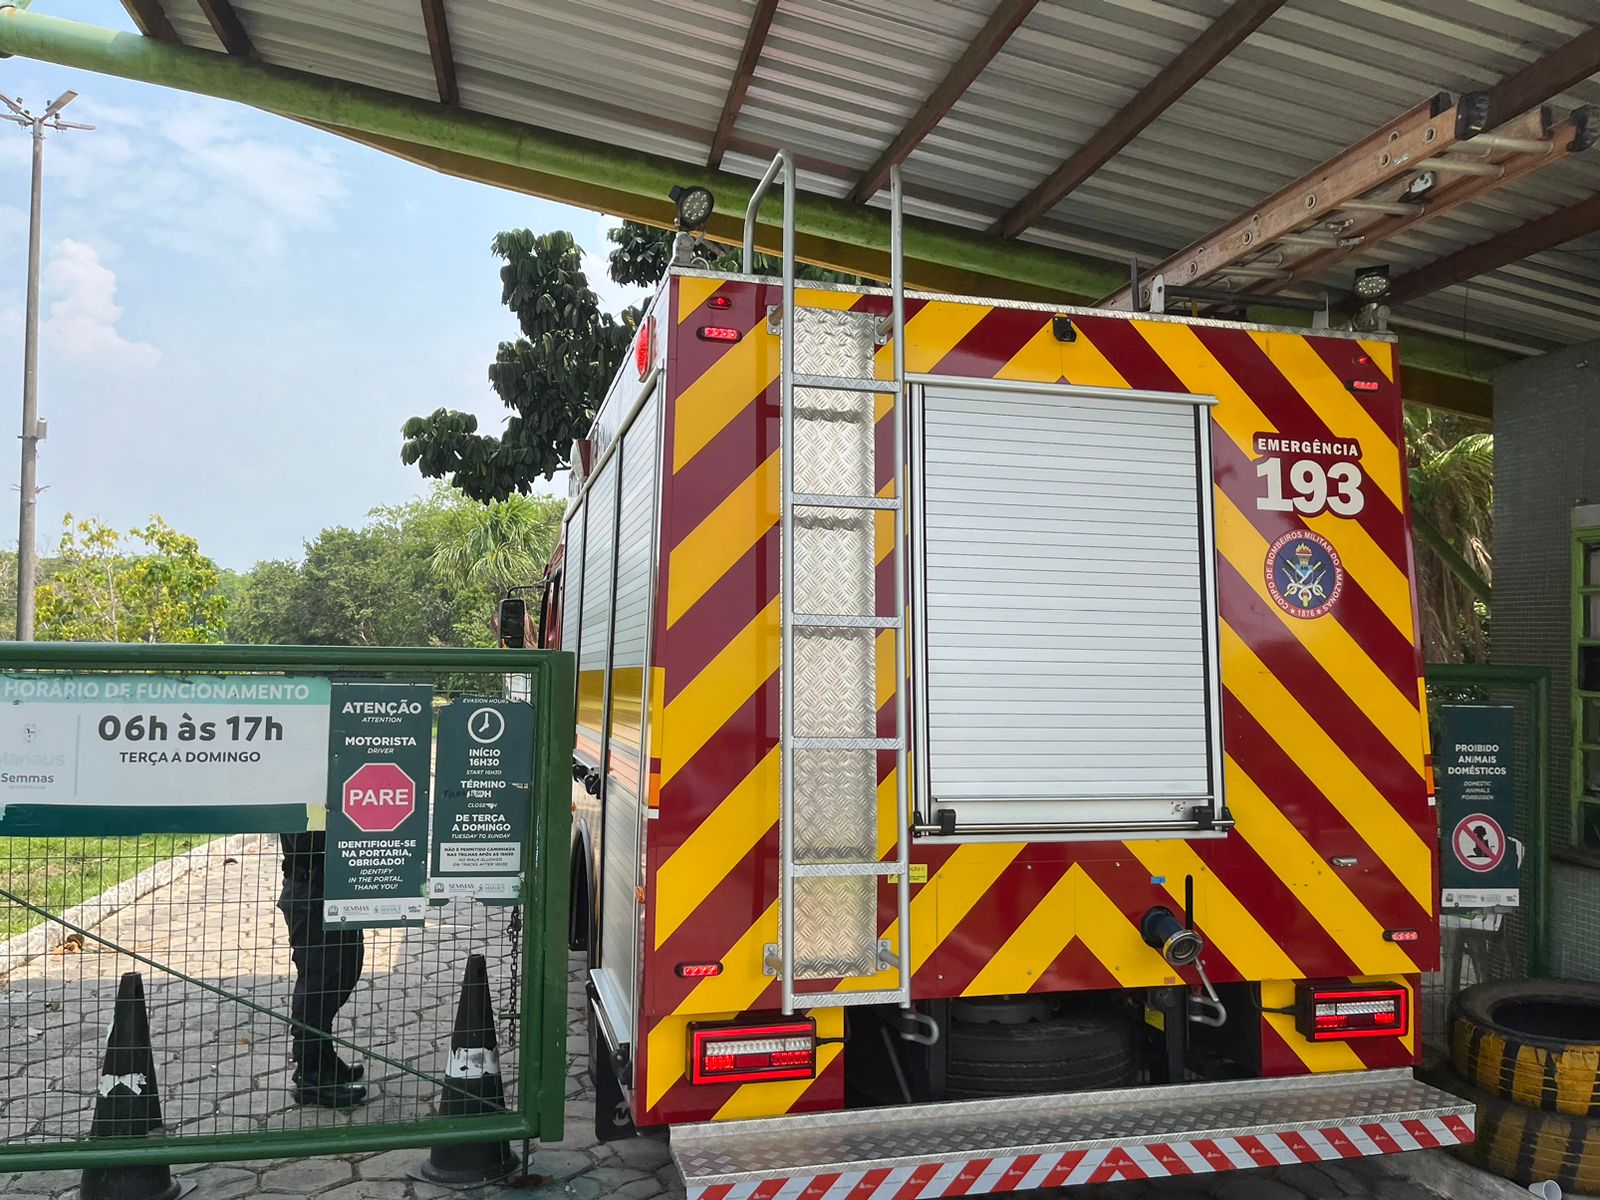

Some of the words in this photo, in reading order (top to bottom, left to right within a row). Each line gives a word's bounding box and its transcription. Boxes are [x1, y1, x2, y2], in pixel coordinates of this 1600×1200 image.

[1258, 438, 1359, 456] EMERGÊNCIA
[1256, 457, 1365, 515] 193
[1304, 531, 1333, 553] MILITAR
[1267, 531, 1303, 567] BOMBEIROS
[1330, 552, 1340, 566] DO
[1266, 568, 1273, 579] DE
[1268, 581, 1289, 609] CORPO
[1322, 568, 1343, 612] AMAZONAS
[1297, 609, 1315, 617] 1876
[105, 682, 131, 698] DE
[136, 682, 310, 700] FUNCIONAMENTO
[342, 699, 422, 716] ATENÇÃO
[98, 714, 168, 742] 06h
[177, 712, 216, 742] às
[226, 715, 284, 742] 17h
[345, 736, 417, 746] MOTORISTA
[469, 747, 501, 757] INÍCIO
[1455, 744, 1500, 752] PROIBIDO
[119, 751, 169, 766] TERÇA
[171, 752, 182, 763] A
[185, 751, 261, 763] DOMINGO
[469, 758, 500, 766] 16H30
[1458, 755, 1497, 764] ANIMAIS
[1447, 765, 1507, 775] DOMÉSTICOS
[0, 772, 54, 783] Semmas
[460, 779, 507, 788] TÉRMINO
[349, 789, 409, 806] PARE
[455, 814, 470, 822] DE
[471, 814, 506, 823] TERÇA
[451, 823, 460, 831] A
[462, 823, 511, 832] DOMINGO
[338, 839, 417, 849] IDENTIFIQUE-SE
[342, 850, 357, 858] NA
[359, 848, 412, 857] PORTARIA,
[348, 858, 405, 867] OBRIGADO!
